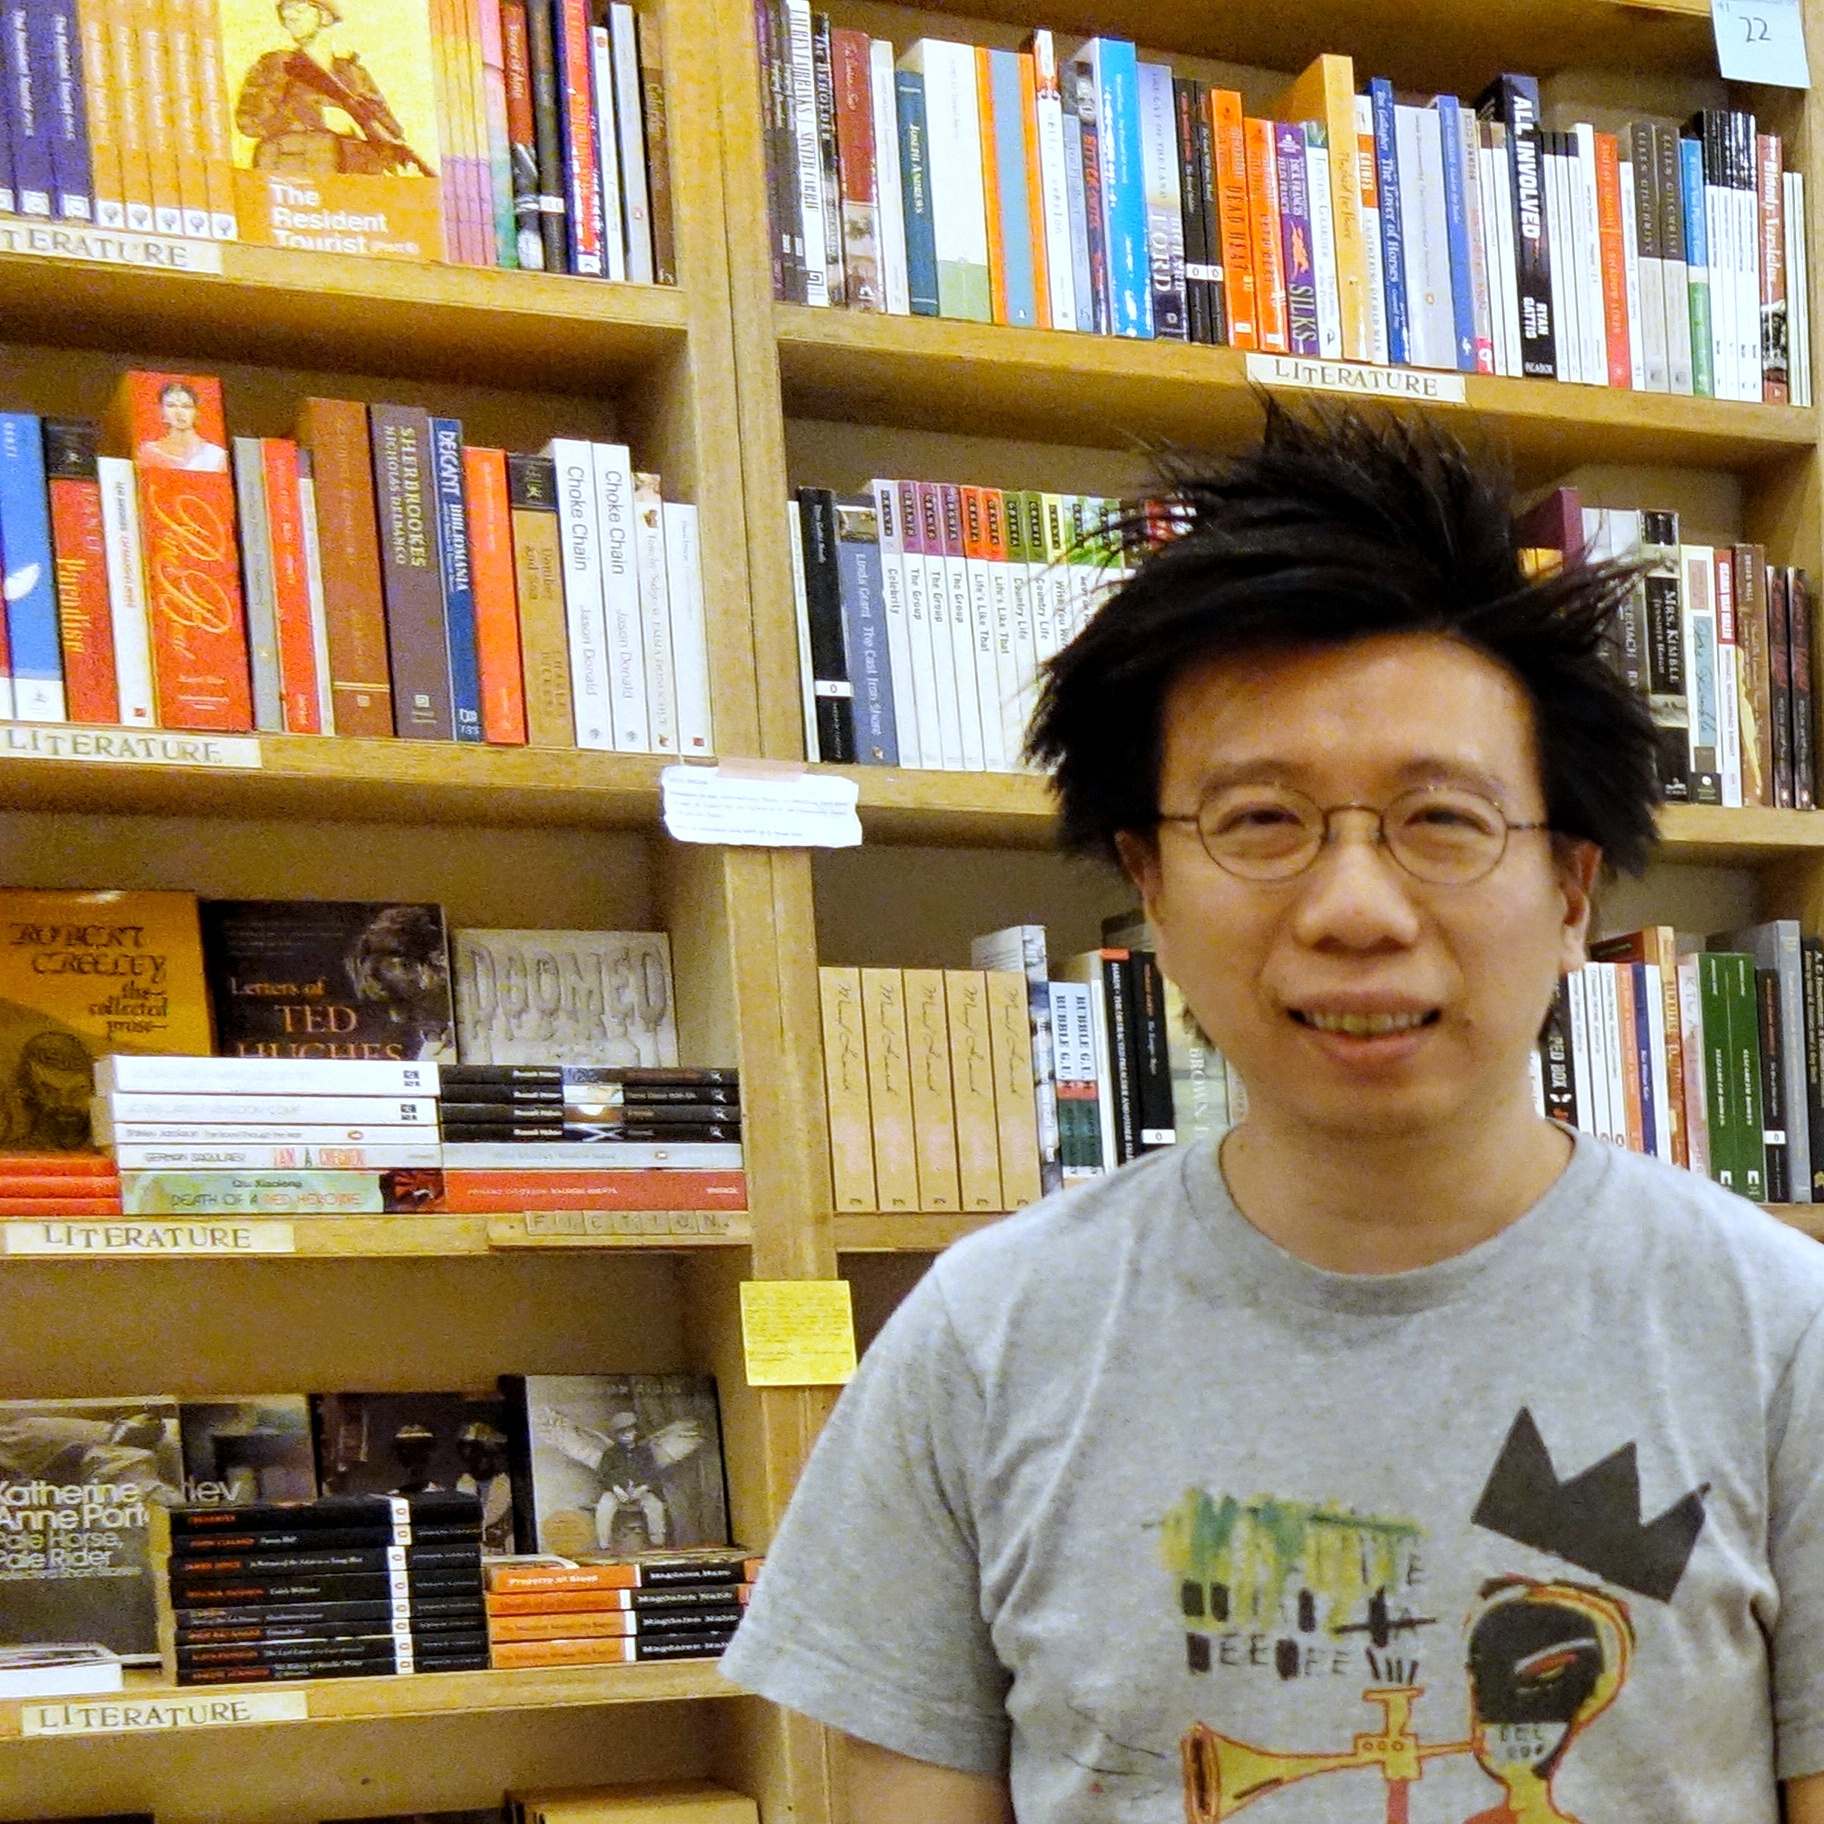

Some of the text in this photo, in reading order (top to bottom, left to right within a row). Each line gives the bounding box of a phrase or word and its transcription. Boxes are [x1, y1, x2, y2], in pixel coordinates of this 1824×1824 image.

[1744, 17, 1771, 42] 22
[1513, 95, 1541, 239] ALL INVOLVED
[271, 205, 389, 234] Resident
[272, 183, 318, 207] The
[272, 228, 368, 254] Tourist
[1288, 283, 1317, 343] SILKS
[1523, 296, 1537, 340] GATTIS
[1535, 302, 1549, 336] RYAN
[1276, 359, 1438, 397] LITERATURE
[438, 430, 460, 497] DESCANT
[401, 427, 427, 568] SHERBROOKES
[390, 496, 408, 566] DELBANCO
[567, 466, 598, 697] Choke Chain Jason Donald
[605, 470, 635, 699] Choke Chain Jason Donald
[888, 568, 901, 614] Celebrity
[910, 568, 923, 620] The Group
[931, 571, 944, 623] The Group
[952, 572, 966, 624] The Group
[973, 573, 990, 653] Life's Like That
[994, 576, 1010, 655] Life's Like That
[1012, 577, 1028, 639] Country Life
[1034, 577, 1050, 639] Country Life
[6, 728, 222, 764] LITERATURE
[9, 922, 146, 951] ROBERT
[230, 976, 325, 998] Letters of
[274, 1004, 357, 1033] TED
[1054, 994, 1070, 1049] BUBBLE
[1075, 995, 1091, 1050] BUBBLE
[1188, 1047, 1208, 1117] BROWN
[43, 1223, 253, 1250] LITERATURE
[49, 1548, 113, 1570] Rider
[40, 1700, 251, 1729] LITERATURE
